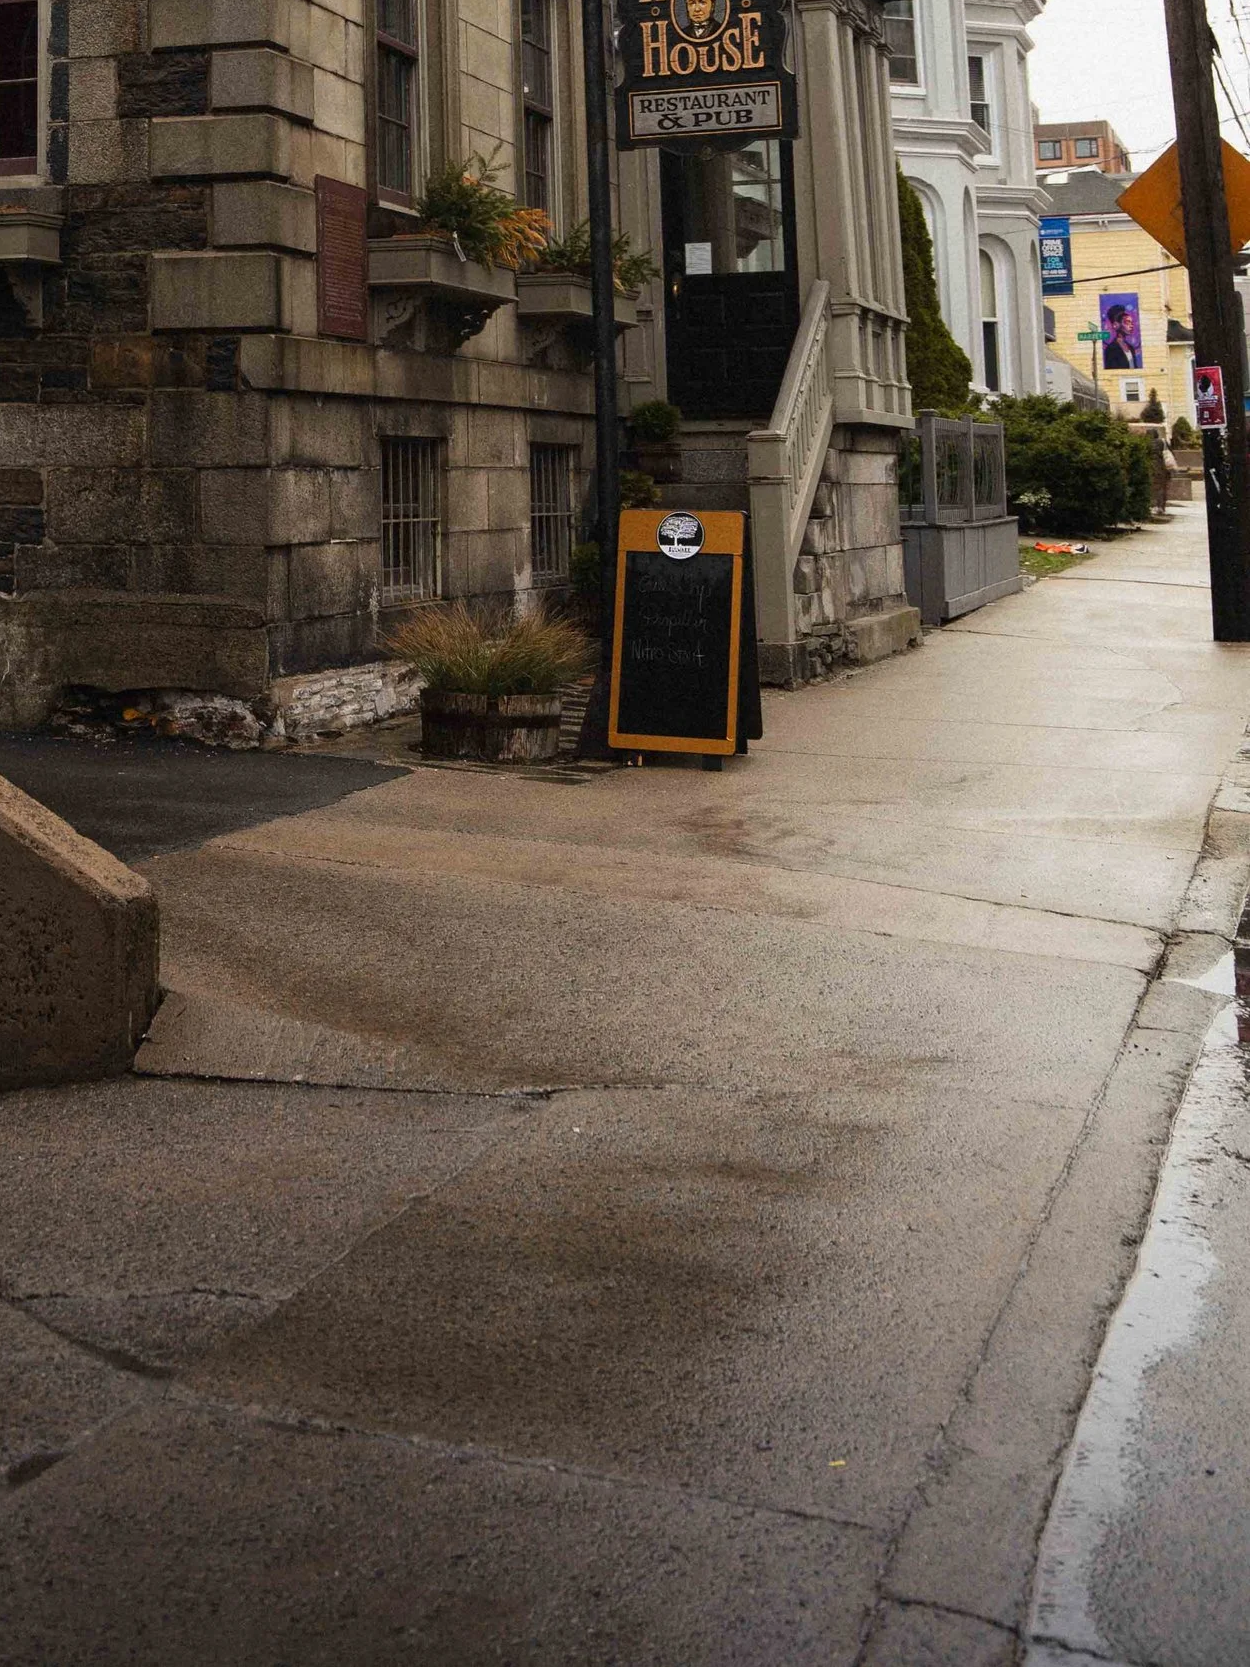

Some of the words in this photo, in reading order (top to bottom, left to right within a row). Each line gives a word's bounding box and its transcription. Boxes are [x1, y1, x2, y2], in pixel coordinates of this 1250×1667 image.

[639, 12, 765, 77] HOUSE
[639, 90, 770, 114] RESTAURANT
[657, 113, 686, 131] &
[693, 109, 753, 127] PUB
